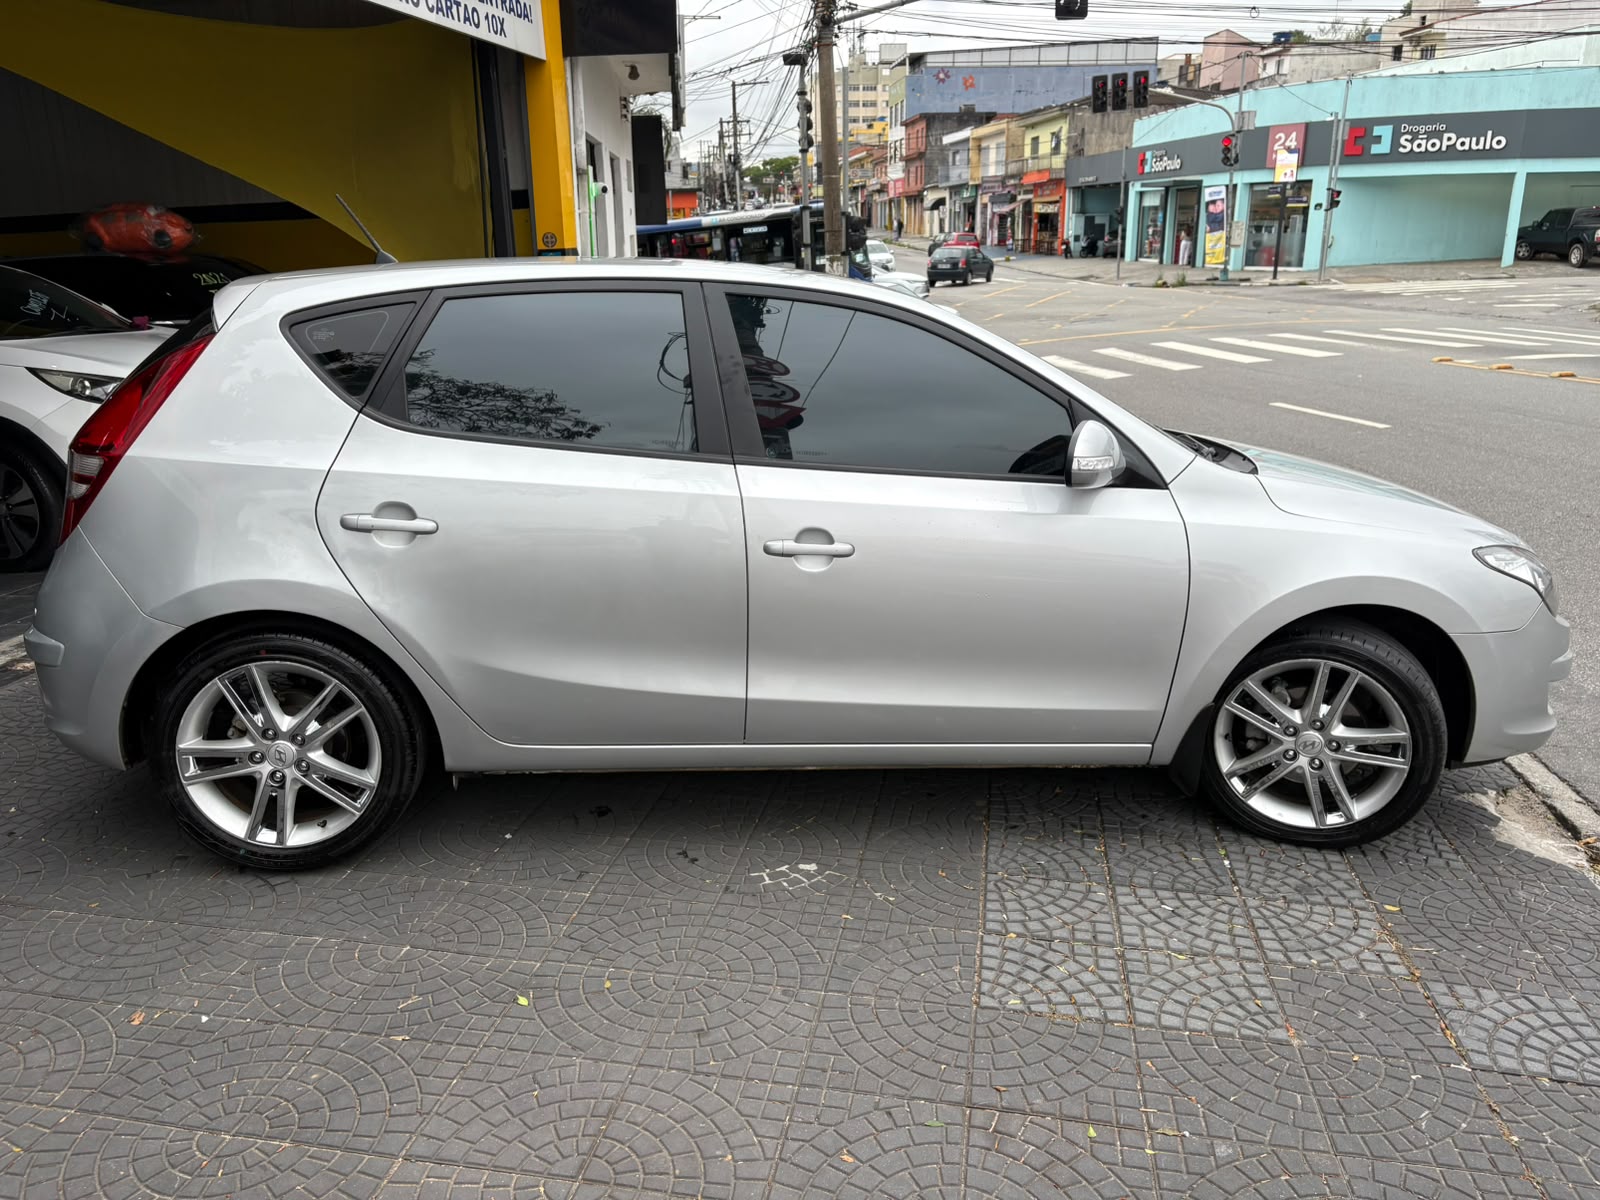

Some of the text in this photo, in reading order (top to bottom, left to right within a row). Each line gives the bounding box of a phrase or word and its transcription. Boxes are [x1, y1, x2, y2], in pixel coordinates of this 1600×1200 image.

[484, 11, 507, 38] 10X
[1401, 123, 1447, 133] Drogaria
[1273, 131, 1298, 150] 24
